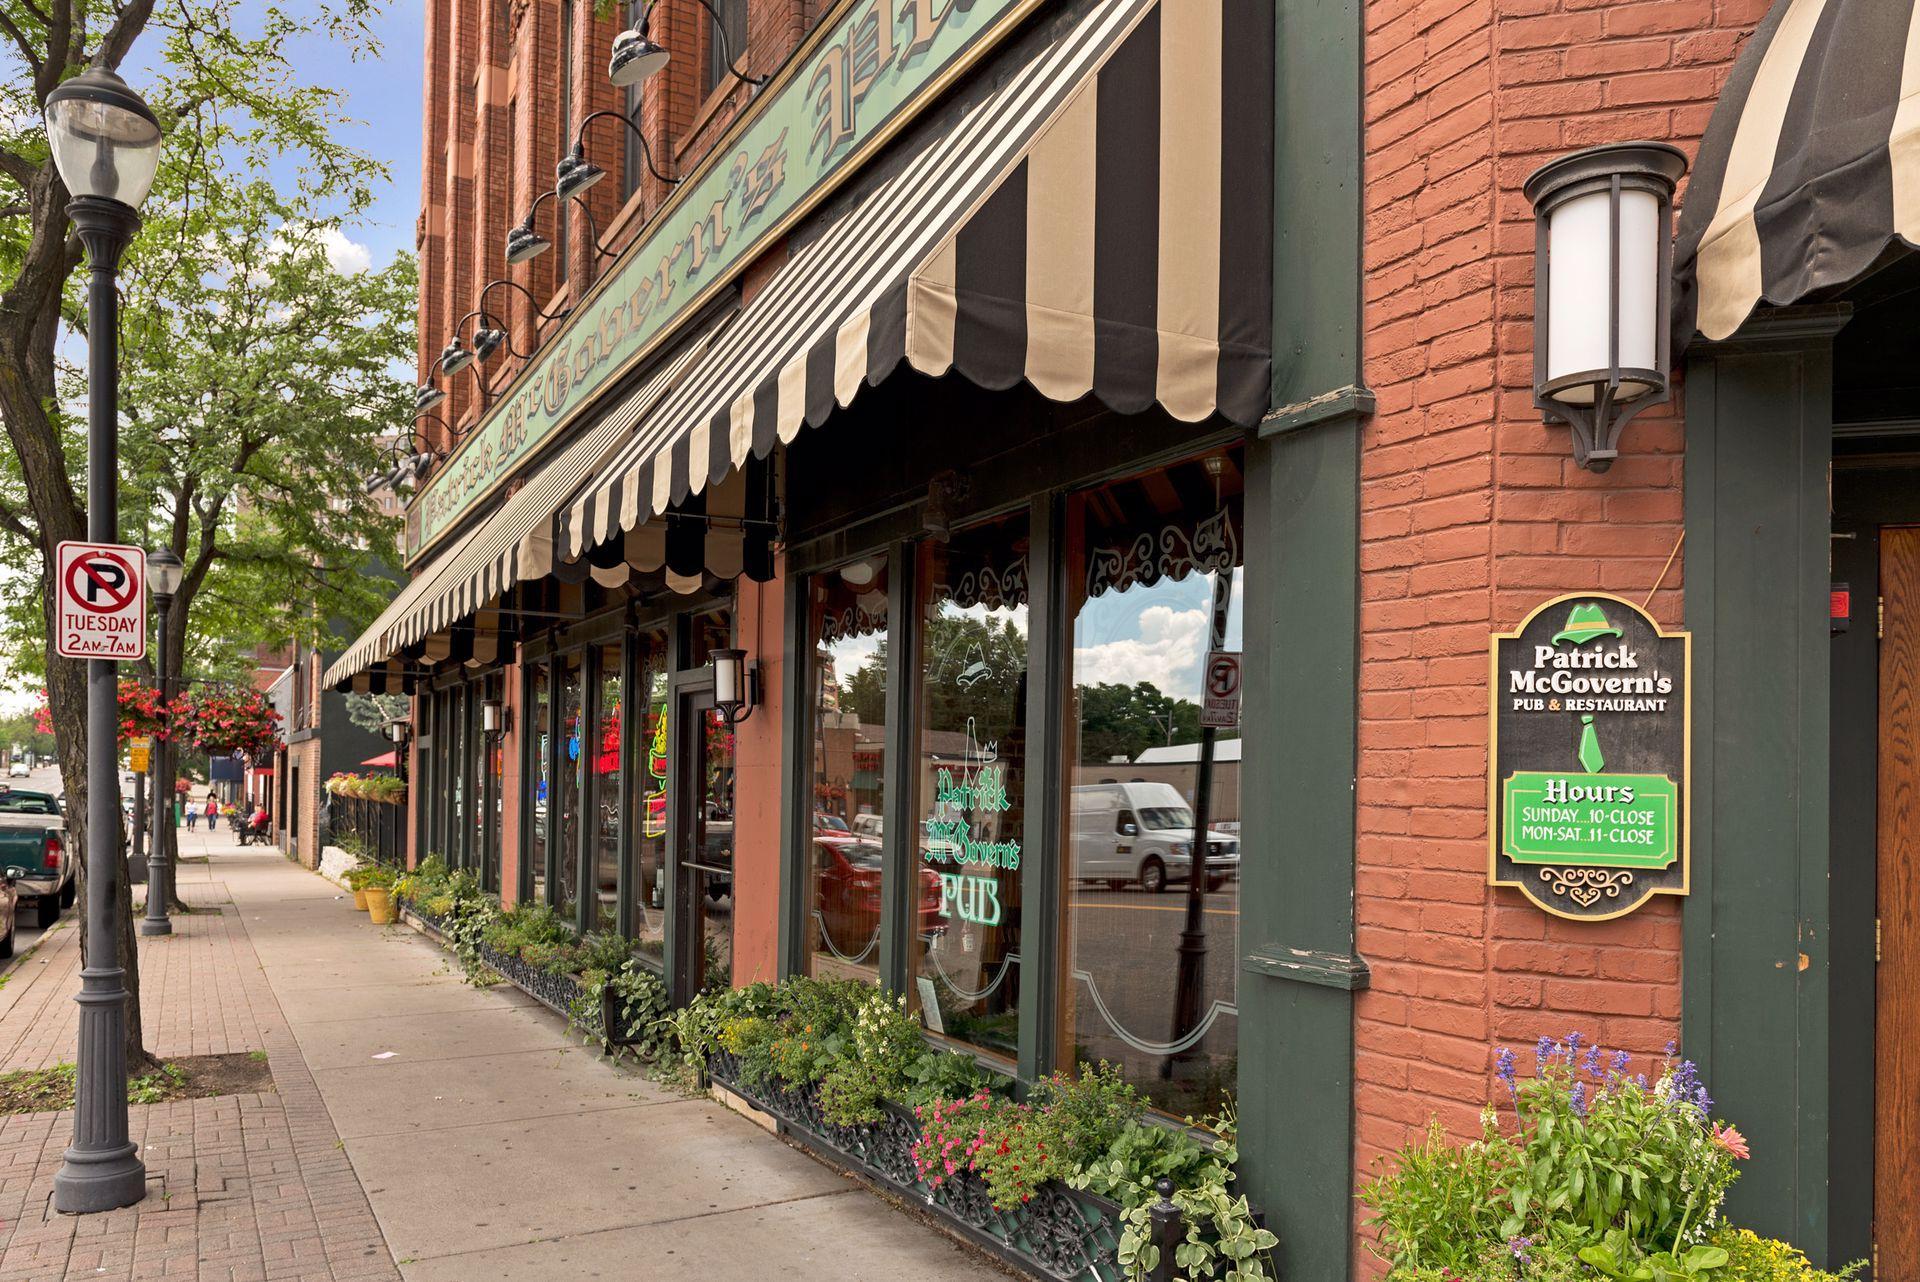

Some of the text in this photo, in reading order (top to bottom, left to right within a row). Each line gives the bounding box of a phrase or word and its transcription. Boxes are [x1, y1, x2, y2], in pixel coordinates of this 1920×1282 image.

[425, 433, 494, 538] Patrick
[494, 127, 789, 478] McGovern's
[65, 614, 137, 633] TUESDAY
[68, 633, 136, 653] 2AM-7AM
[1534, 645, 1638, 669] Patrick
[1509, 670, 1672, 694] McGovern's
[1513, 699, 1667, 712] PUB & RESTAURANT
[938, 765, 1011, 818] Patrick
[1542, 779, 1635, 804] Hours
[925, 817, 1021, 870] McGovern's
[939, 873, 1001, 926] PUB
